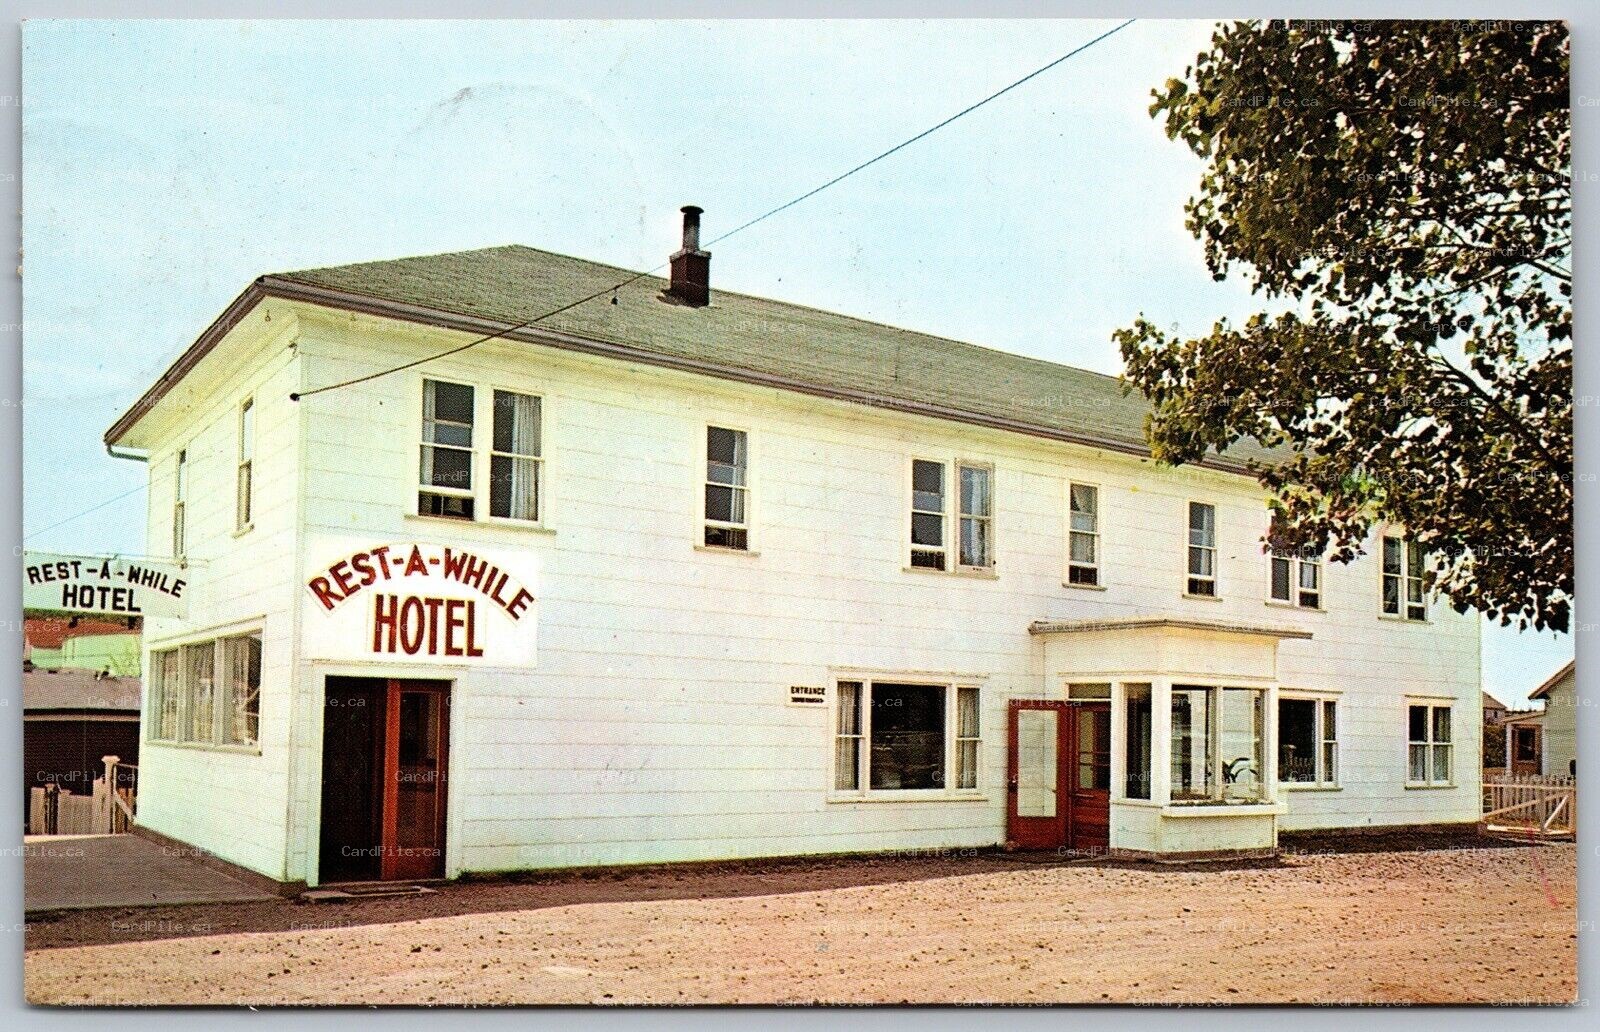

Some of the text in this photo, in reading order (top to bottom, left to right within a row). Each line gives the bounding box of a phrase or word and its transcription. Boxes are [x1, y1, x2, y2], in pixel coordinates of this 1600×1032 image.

[27, 560, 187, 598] REST-A-WHILE
[62, 584, 141, 612] HOTEL
[308, 544, 535, 621] REST-A-WHILE
[373, 594, 484, 657] HOTEL
[790, 685, 826, 696] ENTRANCE
